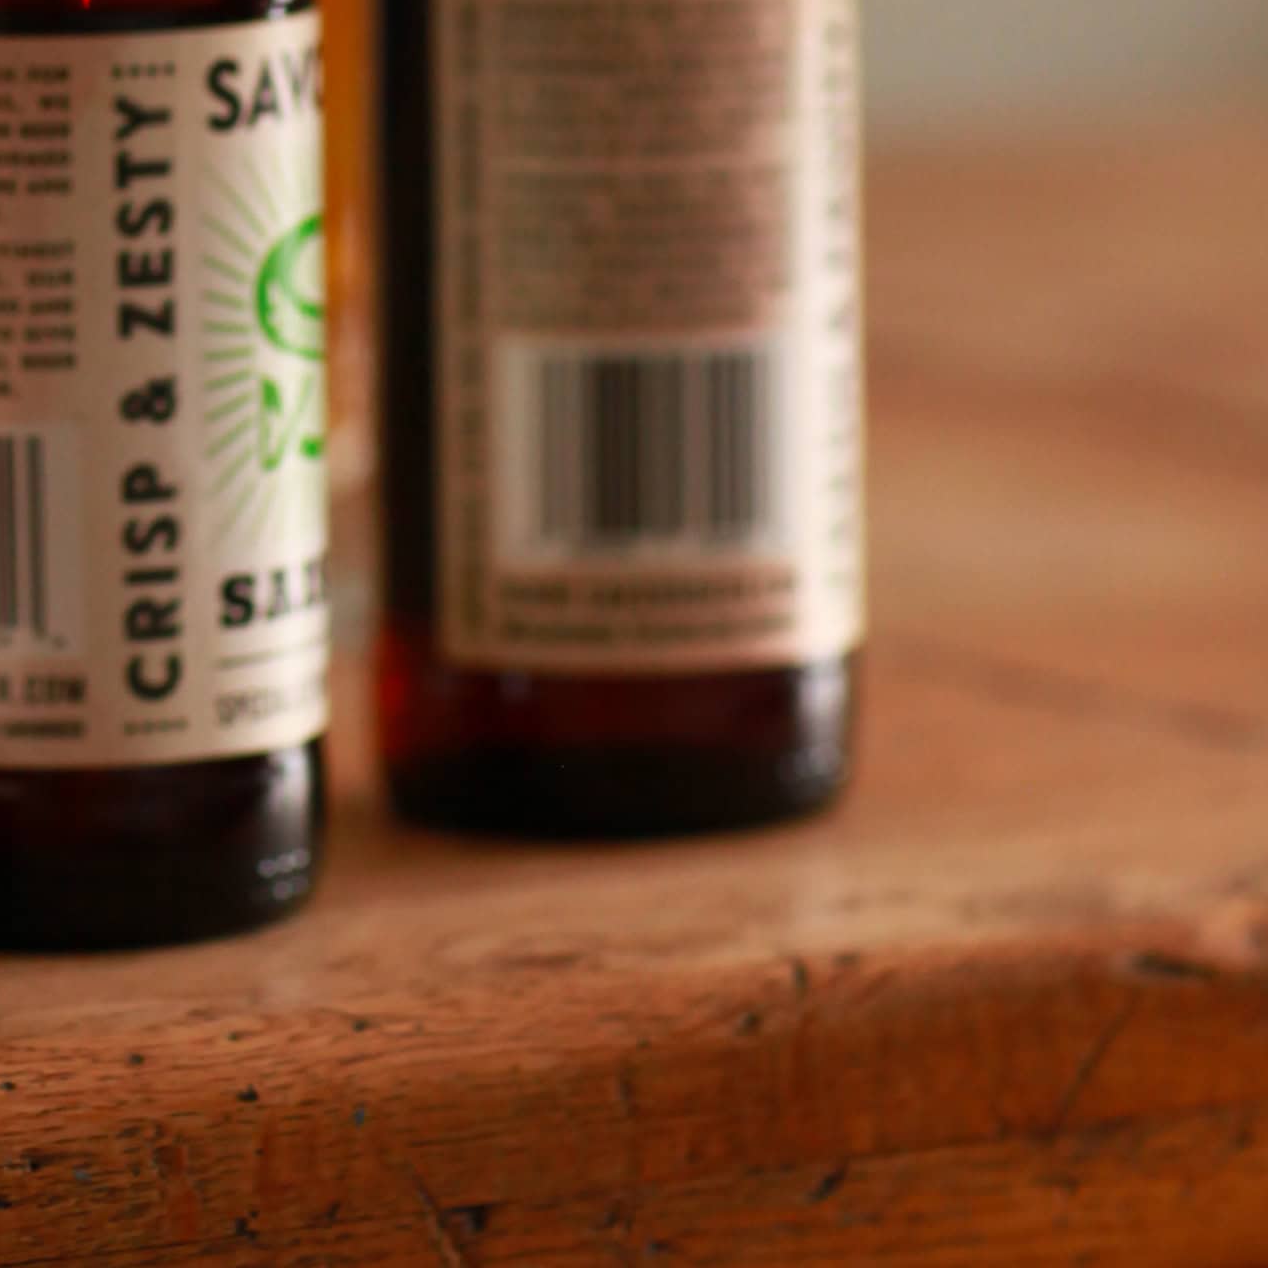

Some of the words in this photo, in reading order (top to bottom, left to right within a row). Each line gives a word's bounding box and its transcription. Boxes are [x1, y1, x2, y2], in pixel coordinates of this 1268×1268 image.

[207, 44, 323, 132] SAV
[113, 93, 176, 339] ZESTY
[119, 376, 177, 425] &
[120, 461, 182, 700] CRISP
